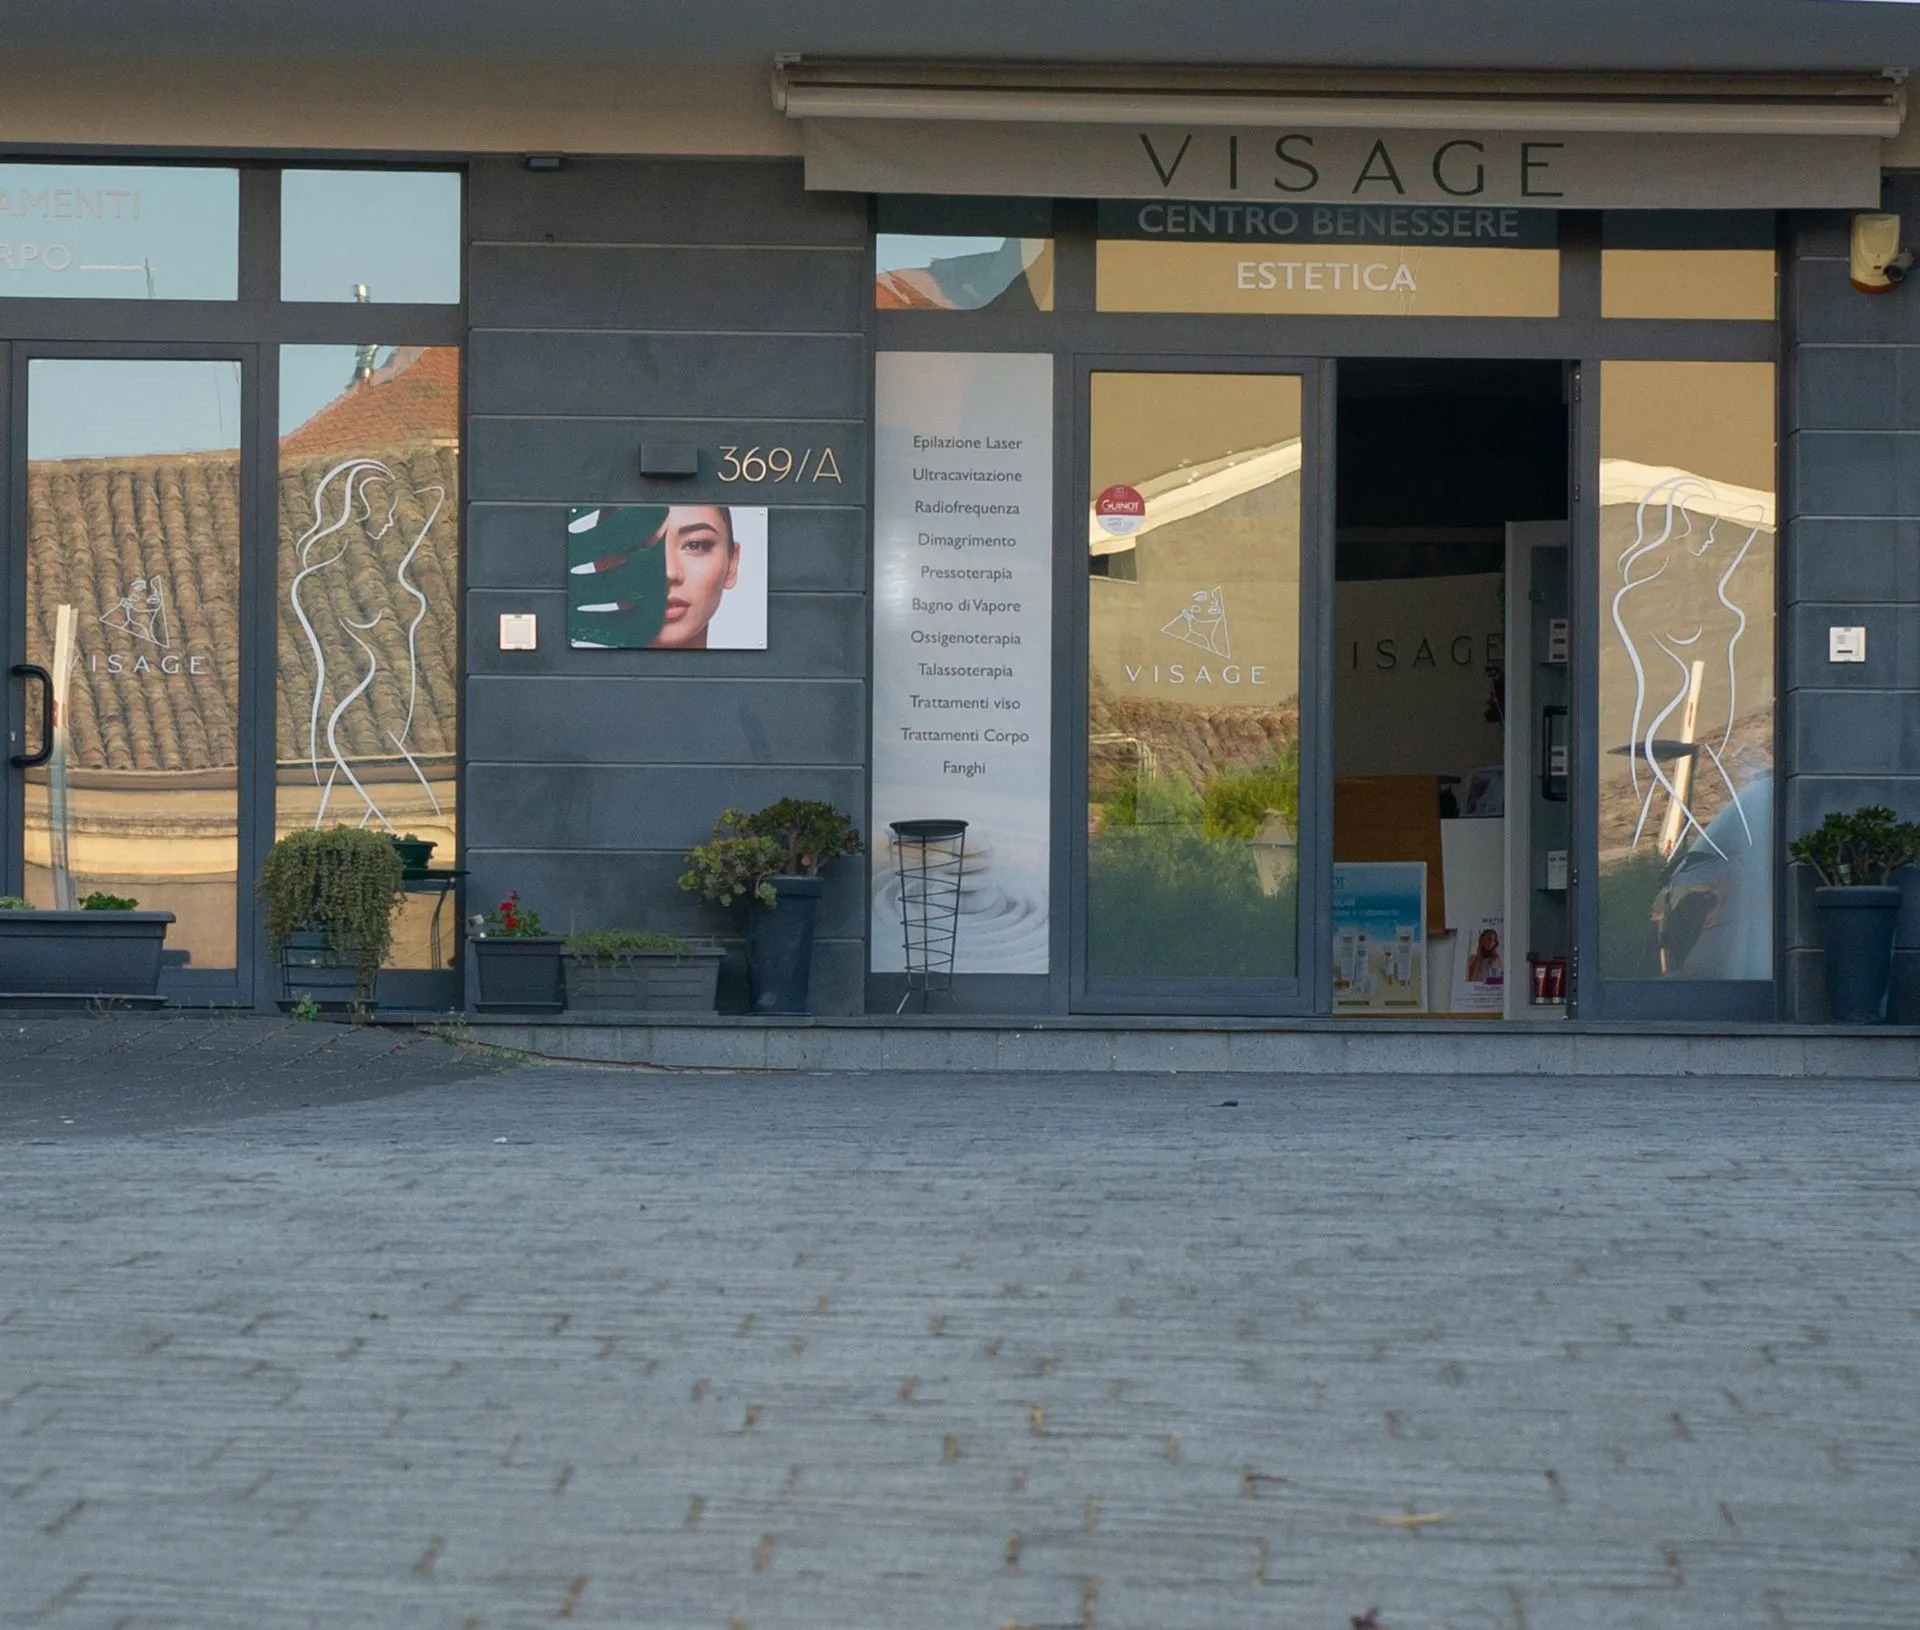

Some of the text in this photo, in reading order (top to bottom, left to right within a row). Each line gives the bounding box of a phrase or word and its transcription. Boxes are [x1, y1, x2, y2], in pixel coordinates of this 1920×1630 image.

[1139, 133, 1565, 198] VISAGE
[1138, 204, 1519, 239] CENTRO BENESSERE
[1236, 261, 1417, 292] ESTETICA
[913, 434, 1023, 451] Epilazione Laser
[717, 444, 843, 485] 369/A
[912, 467, 1024, 482] Ultracavitazione
[915, 500, 1020, 517] Radiofrequenza
[918, 532, 1017, 550] Dimagrimento
[921, 565, 1013, 582] Pressoterapia
[912, 598, 1022, 615] Bagno di Vapore
[910, 630, 1022, 648] Ossigenoterapia
[918, 662, 1014, 680] Talassoterapia
[1125, 663, 1267, 685] VISAGE
[909, 694, 1022, 711] Trattamenti viso
[900, 727, 1030, 746] Trattamenti Corpo
[942, 760, 987, 778] Fanghi
